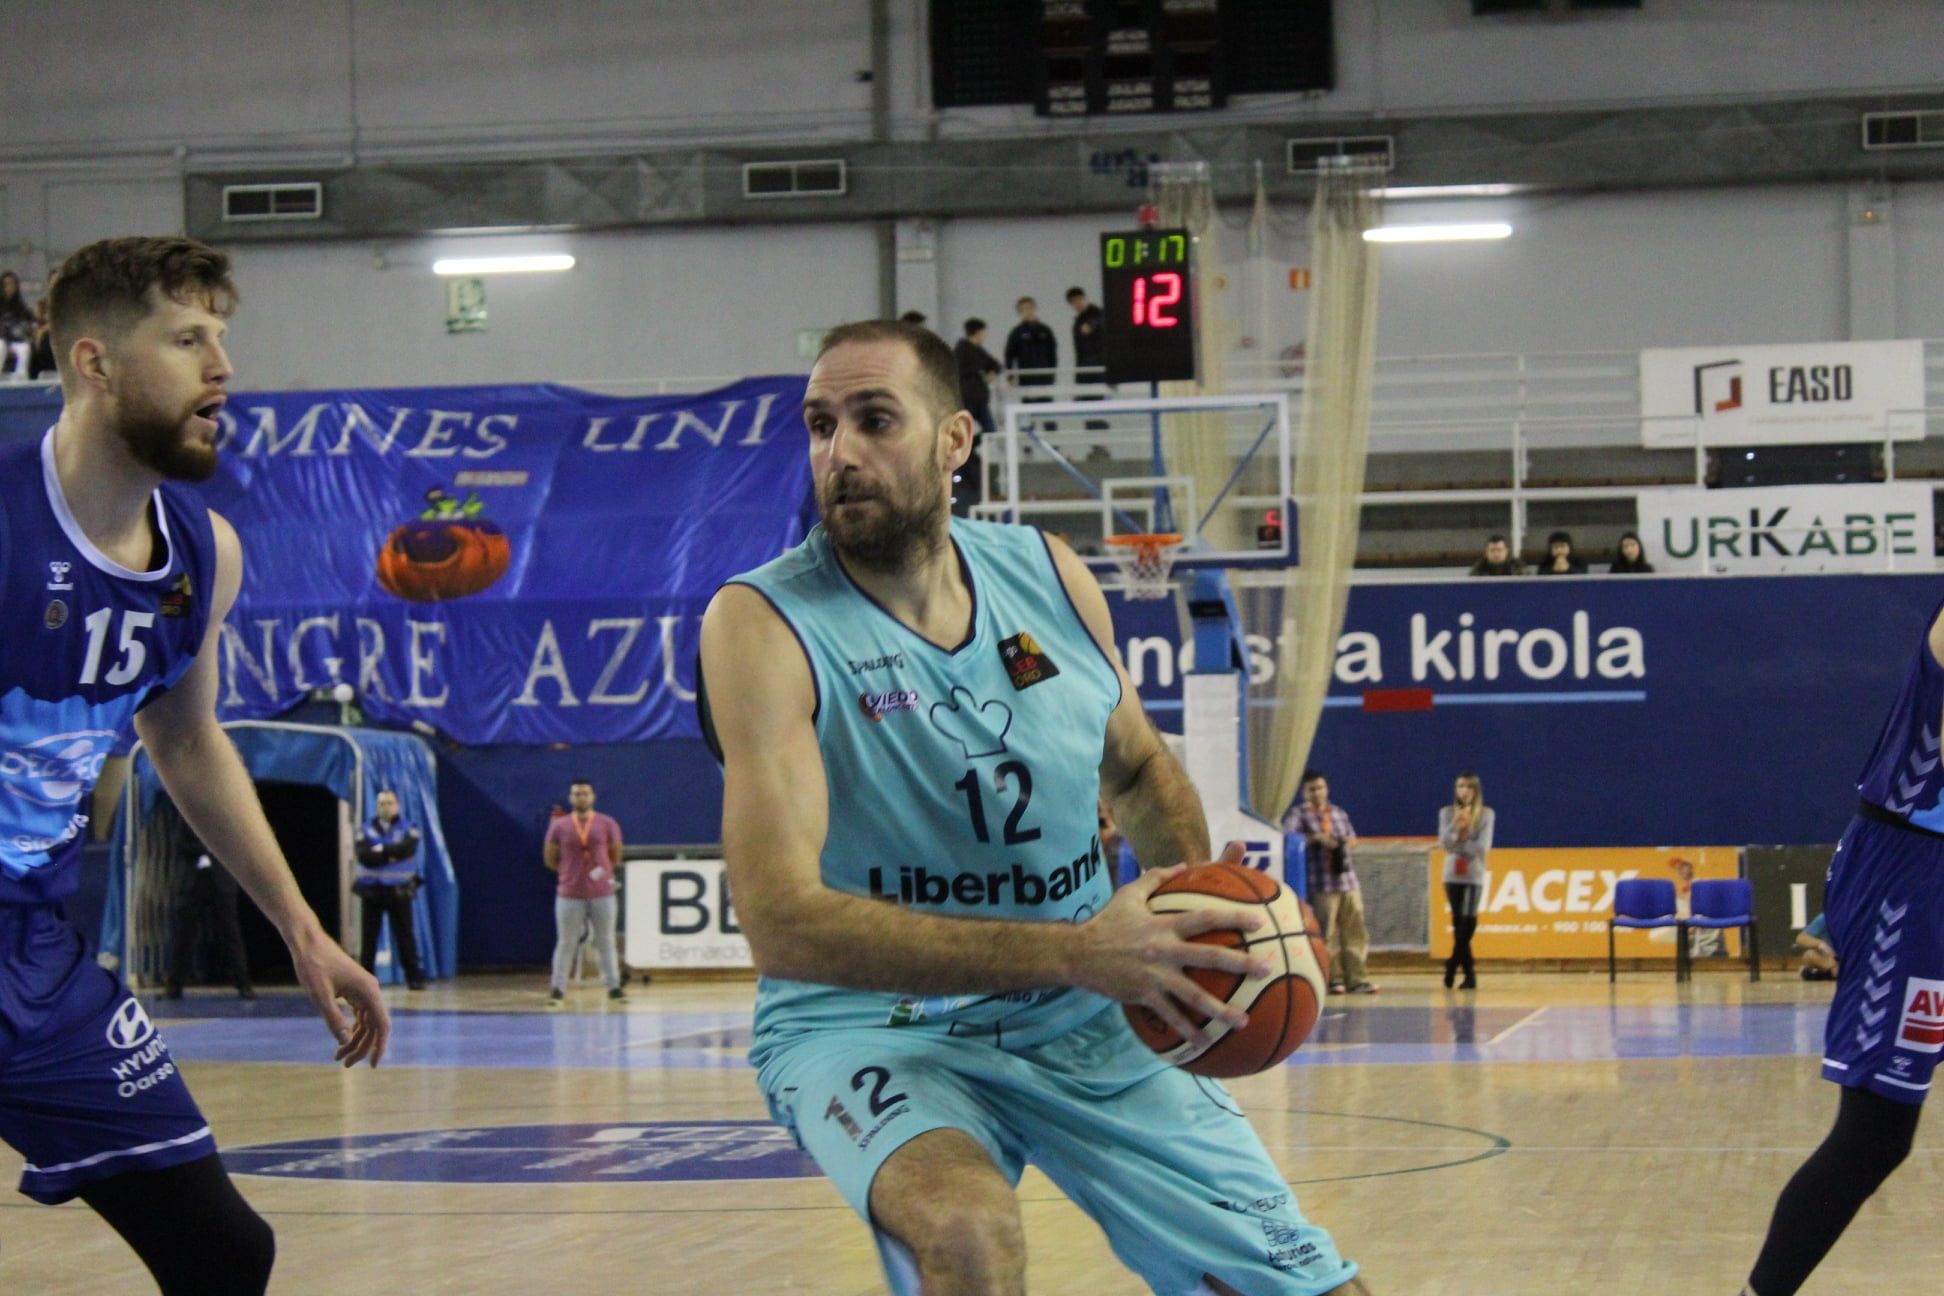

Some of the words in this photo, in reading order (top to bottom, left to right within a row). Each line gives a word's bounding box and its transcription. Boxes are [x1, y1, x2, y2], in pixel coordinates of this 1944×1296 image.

[1106, 235, 1184, 267] 01:17
[1133, 272, 1181, 327] 12
[1769, 364, 1852, 403] EASO
[582, 394, 778, 451] UNI
[1663, 507, 1916, 559] URKABE
[79, 606, 155, 685] 15
[1410, 609, 1646, 682] kirola
[954, 760, 1042, 845] 12
[869, 834, 1103, 905] Liberbank
[824, 1065, 909, 1141] 12
